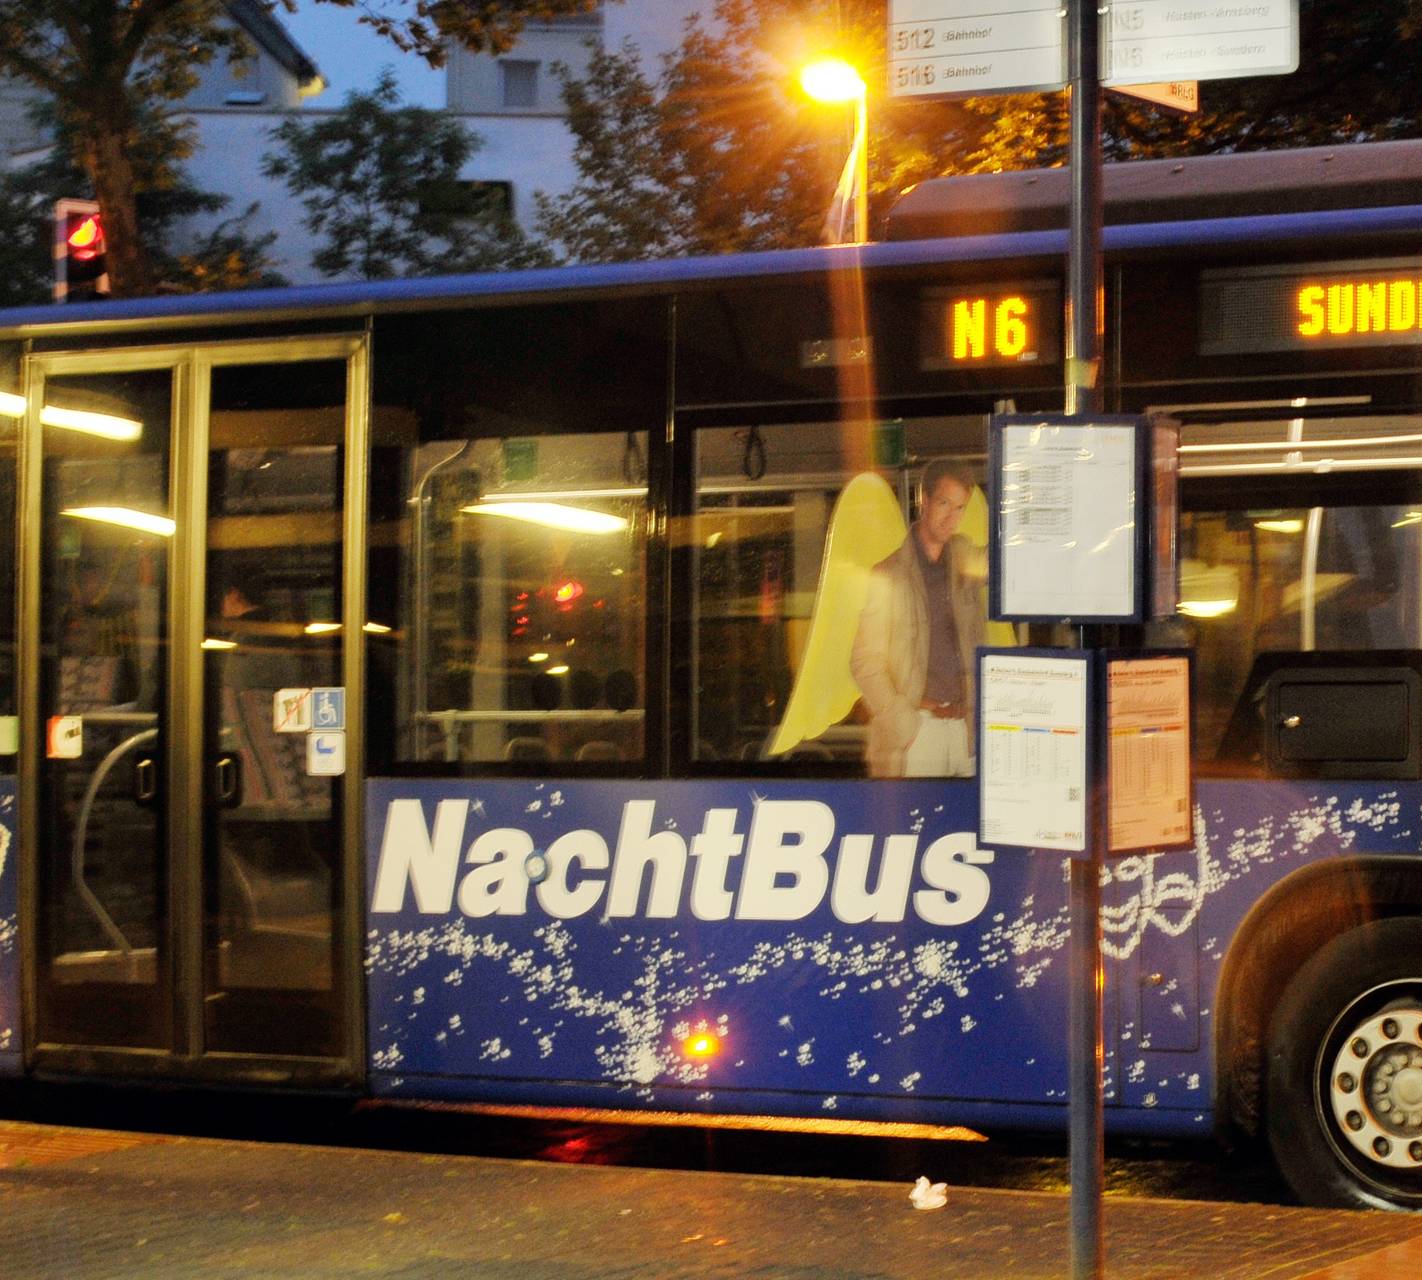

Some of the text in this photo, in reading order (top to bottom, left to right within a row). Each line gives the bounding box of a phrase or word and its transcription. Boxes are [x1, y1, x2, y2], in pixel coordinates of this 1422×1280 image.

[895, 28, 936, 51] 512
[896, 64, 937, 88] 516
[371, 799, 994, 925] NachtBus
